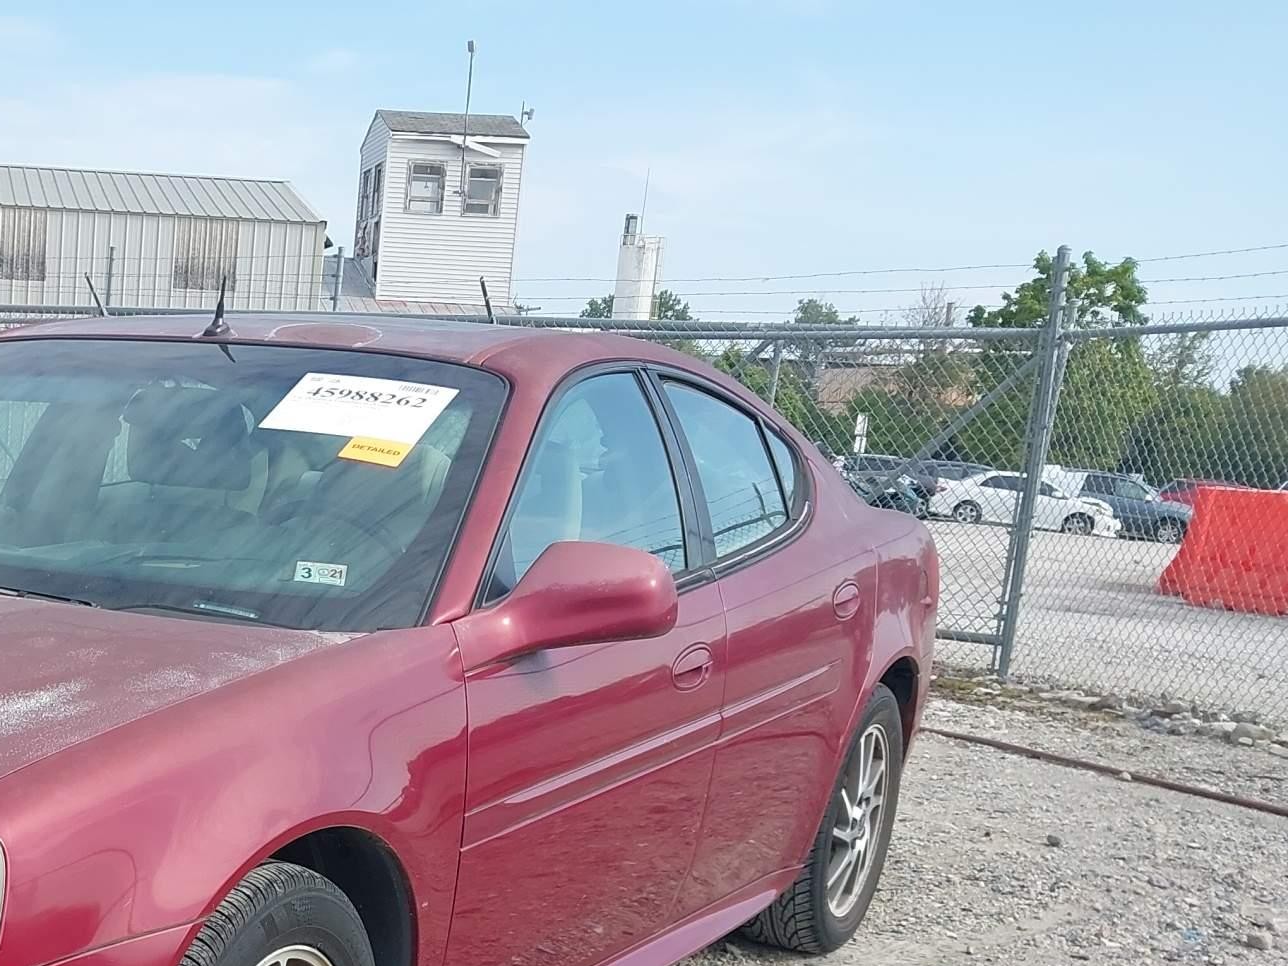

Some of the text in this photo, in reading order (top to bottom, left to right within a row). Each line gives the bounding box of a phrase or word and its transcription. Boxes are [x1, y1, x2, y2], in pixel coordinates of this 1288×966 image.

[307, 386, 426, 408] 45988262
[352, 443, 401, 456] DETAILED
[300, 567, 343, 579] 3 21
